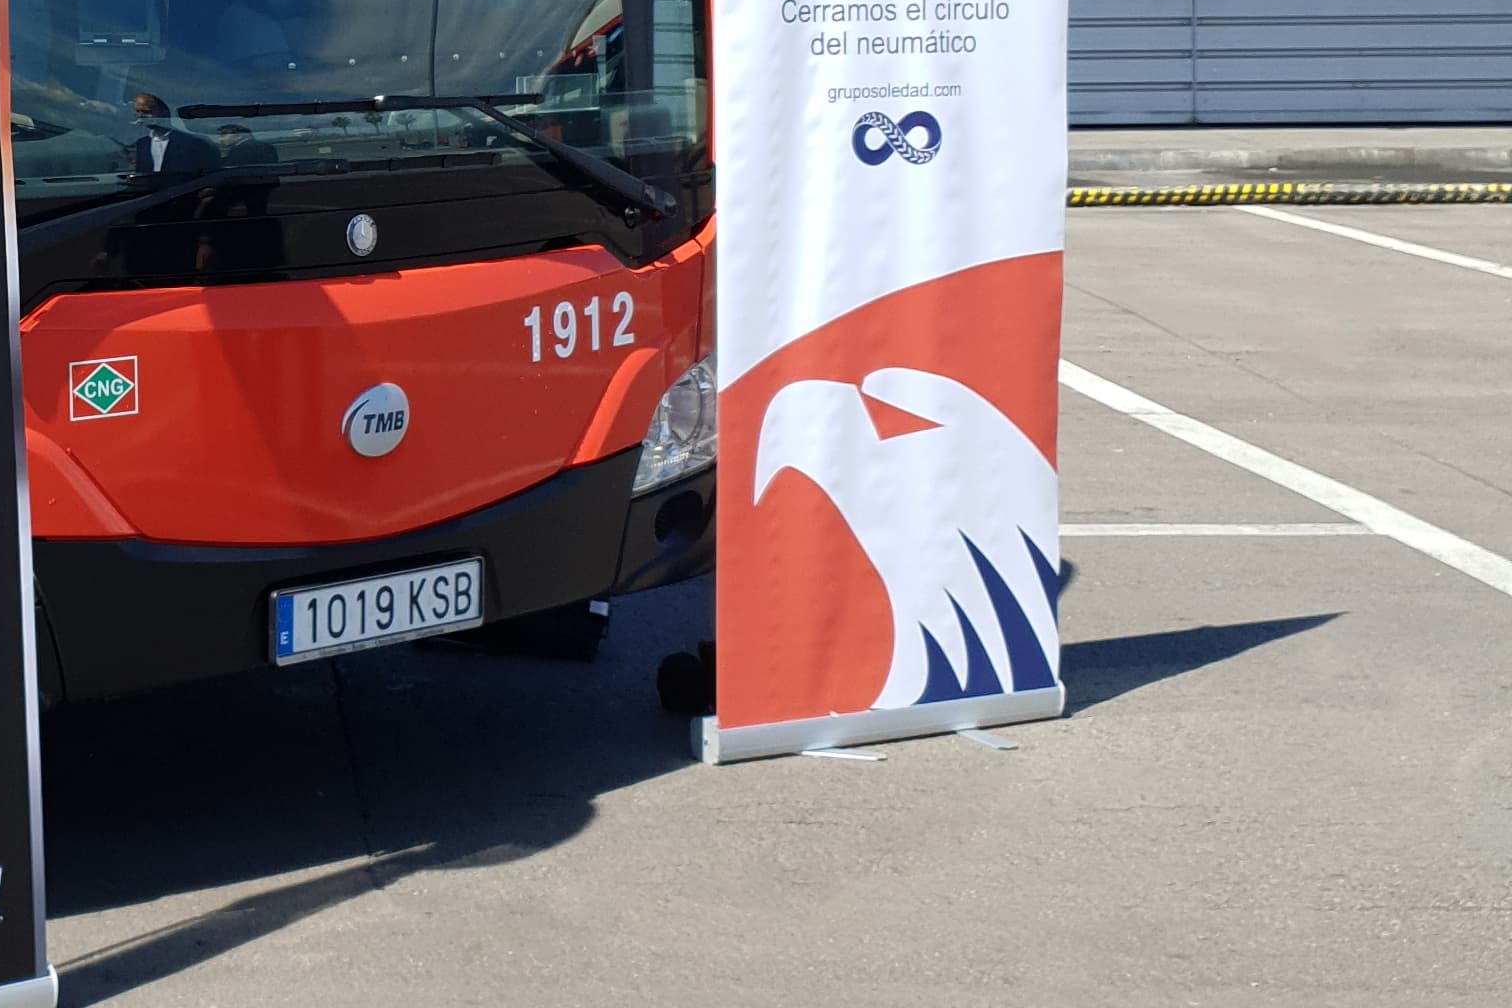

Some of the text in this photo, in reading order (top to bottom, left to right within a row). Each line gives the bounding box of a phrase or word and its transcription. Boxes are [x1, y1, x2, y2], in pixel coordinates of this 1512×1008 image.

[810, 30, 977, 56] del neumático
[827, 83, 962, 104] gruposoledad.com
[524, 291, 635, 363] 1912
[84, 378, 124, 399] CNG
[362, 410, 405, 434] TMB
[307, 571, 472, 643] 1019 KSB
